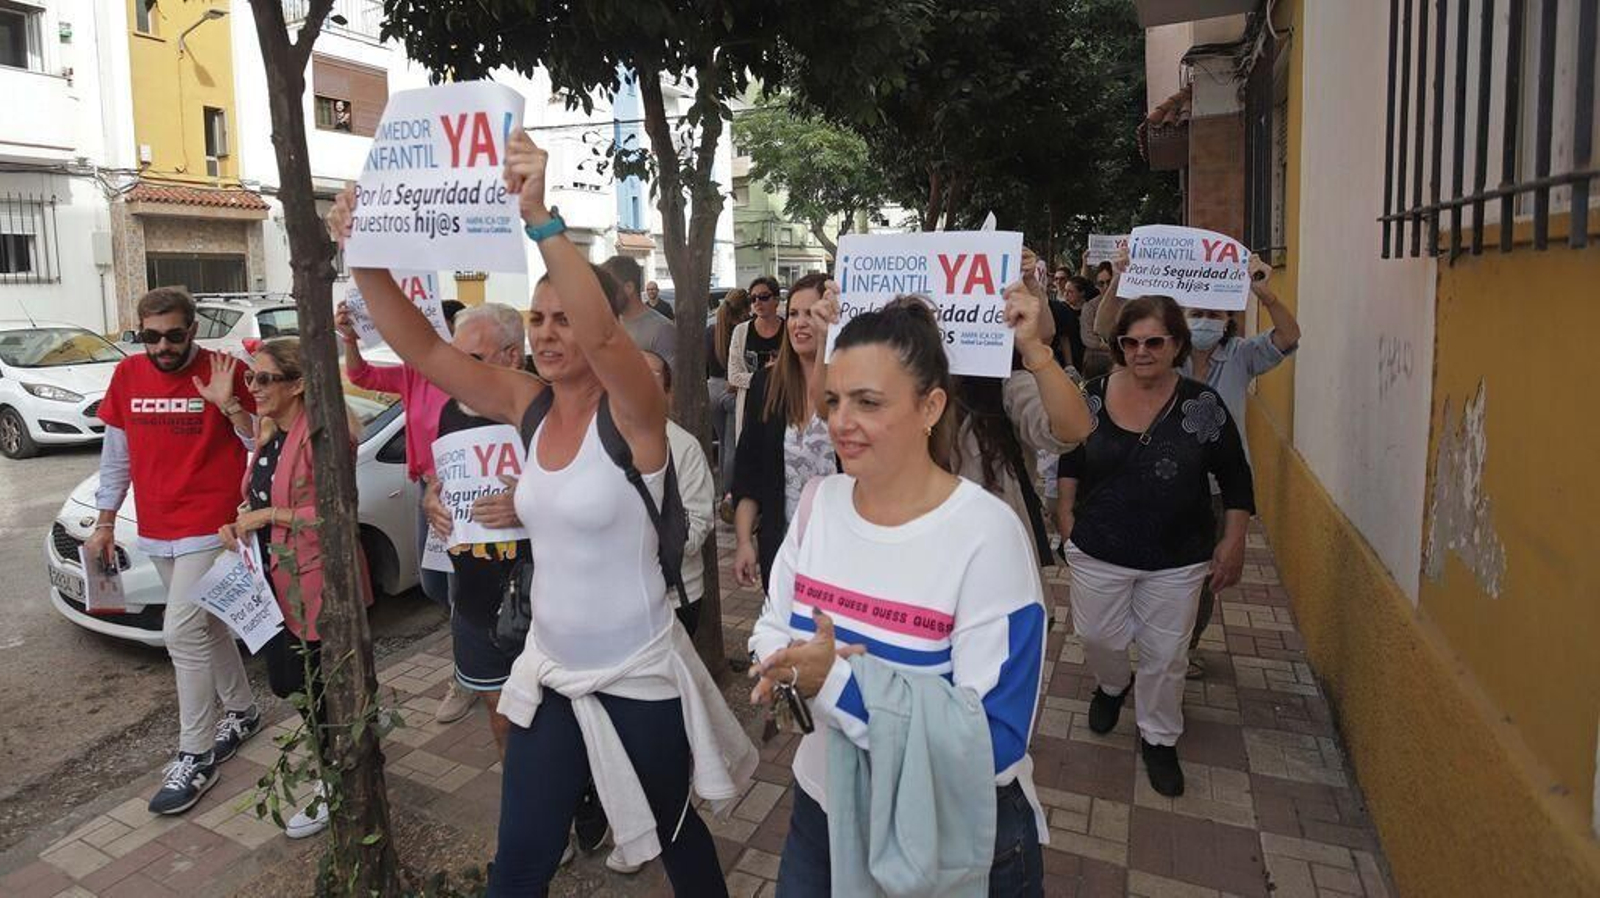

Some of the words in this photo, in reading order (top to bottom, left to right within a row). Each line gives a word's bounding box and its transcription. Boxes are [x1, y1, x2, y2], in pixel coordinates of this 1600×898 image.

[355, 184, 377, 207] Por
[377, 183, 391, 203] la
[394, 180, 482, 211] Seguridad
[485, 179, 507, 204] de
[351, 213, 411, 233] nuestros
[414, 211, 460, 239] hij@s
[1141, 236, 1195, 248] COMEDOR
[1138, 247, 1197, 261] INFANTIL
[853, 255, 928, 272] COMEDOR
[1128, 263, 1149, 276] Por
[1150, 264, 1163, 277] la
[1162, 264, 1229, 280] Seguridad
[1229, 268, 1246, 281] de
[851, 274, 933, 295] INFANTIL
[1126, 276, 1175, 289] nuestros
[1176, 279, 1211, 293] hij@s
[982, 304, 1005, 324] de
